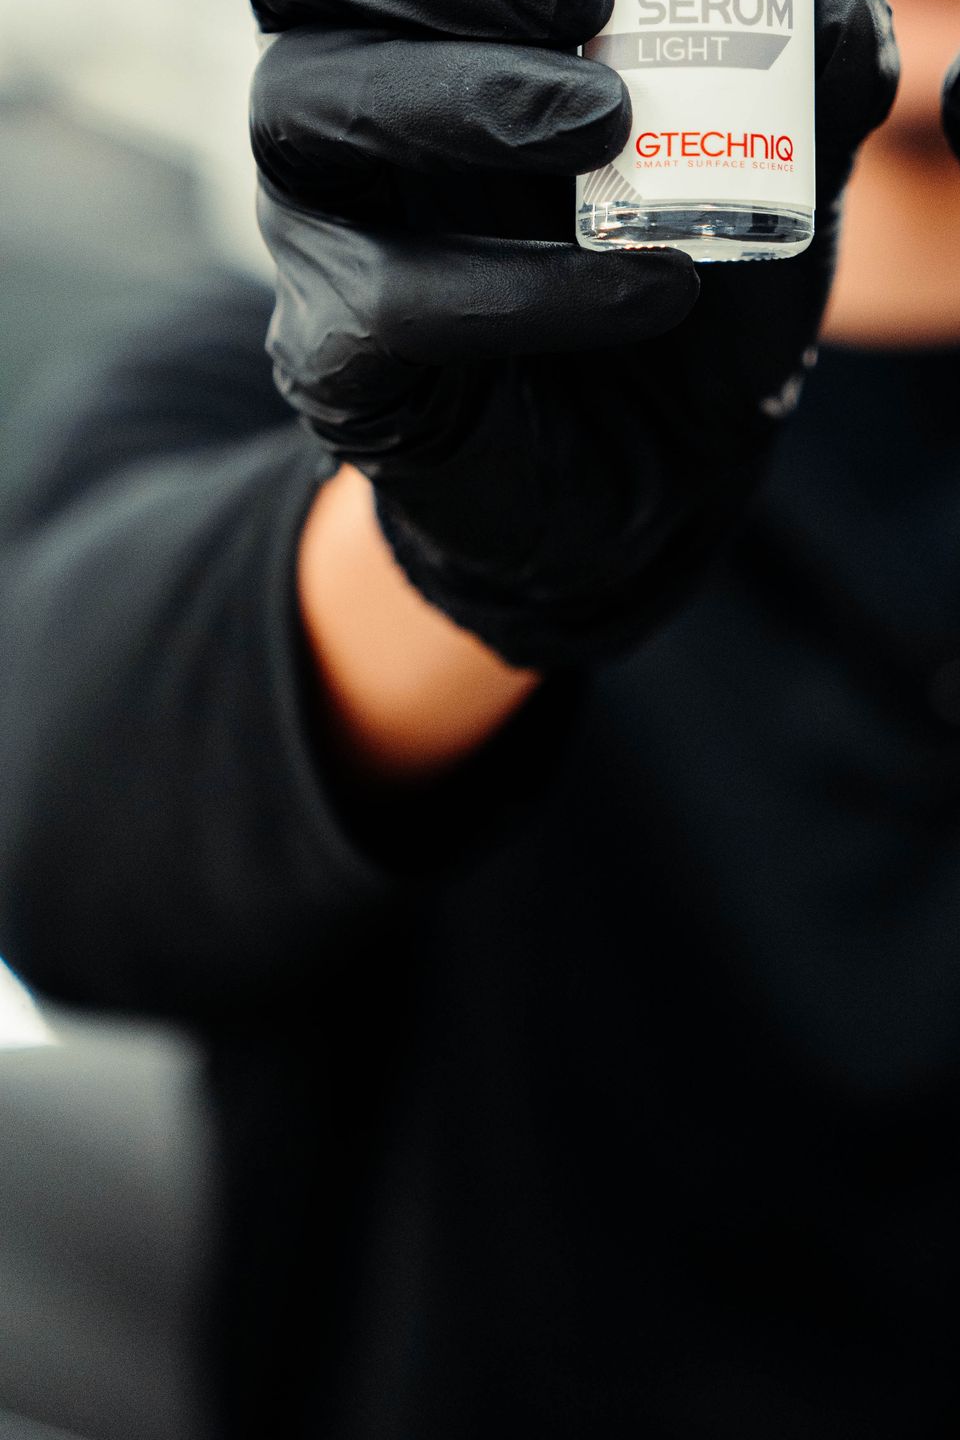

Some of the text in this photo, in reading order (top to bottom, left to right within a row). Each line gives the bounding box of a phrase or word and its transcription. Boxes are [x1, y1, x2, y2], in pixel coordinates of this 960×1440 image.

[638, 36, 730, 62] LIGHT
[635, 131, 794, 162] GTECHNIQ
[636, 159, 795, 173] SMART SURFACE SCIENCE
